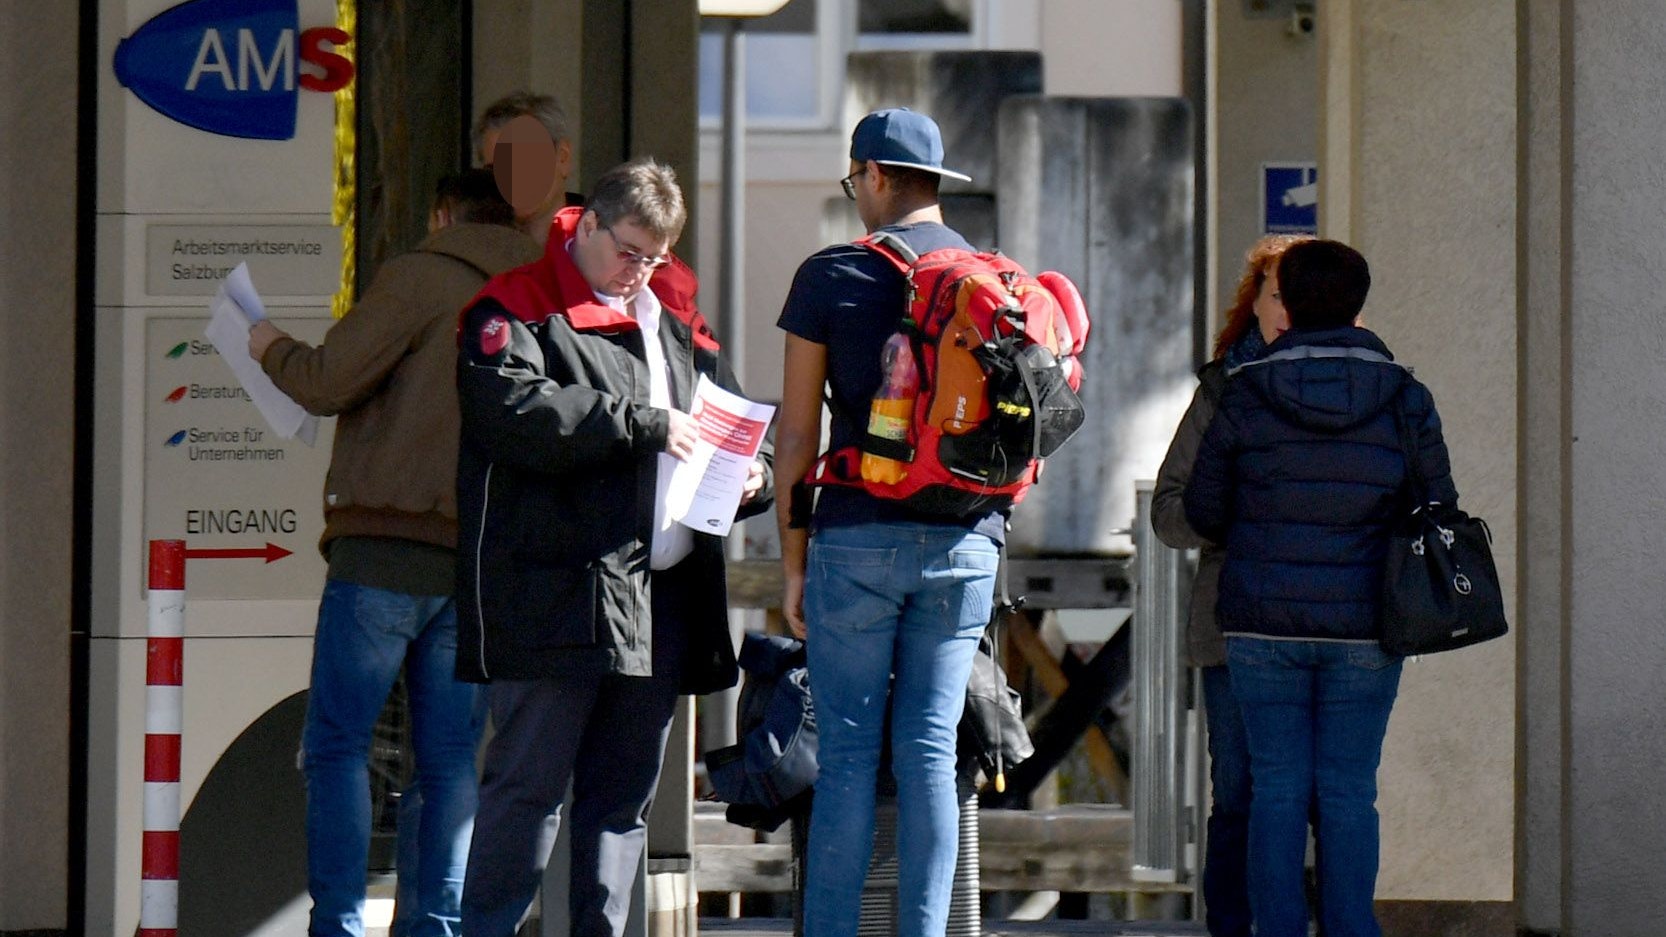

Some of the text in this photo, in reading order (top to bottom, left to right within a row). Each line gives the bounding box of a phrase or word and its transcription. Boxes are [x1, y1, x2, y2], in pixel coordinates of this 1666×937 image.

[184, 27, 355, 92] AMS
[172, 239, 322, 256] Arbeitsmarktservice
[172, 263, 234, 280] Salzbur
[953, 395, 967, 429] PEPS
[188, 427, 264, 443] Service für
[188, 447, 284, 461] Unternehmen
[186, 509, 297, 534] EINGANG
